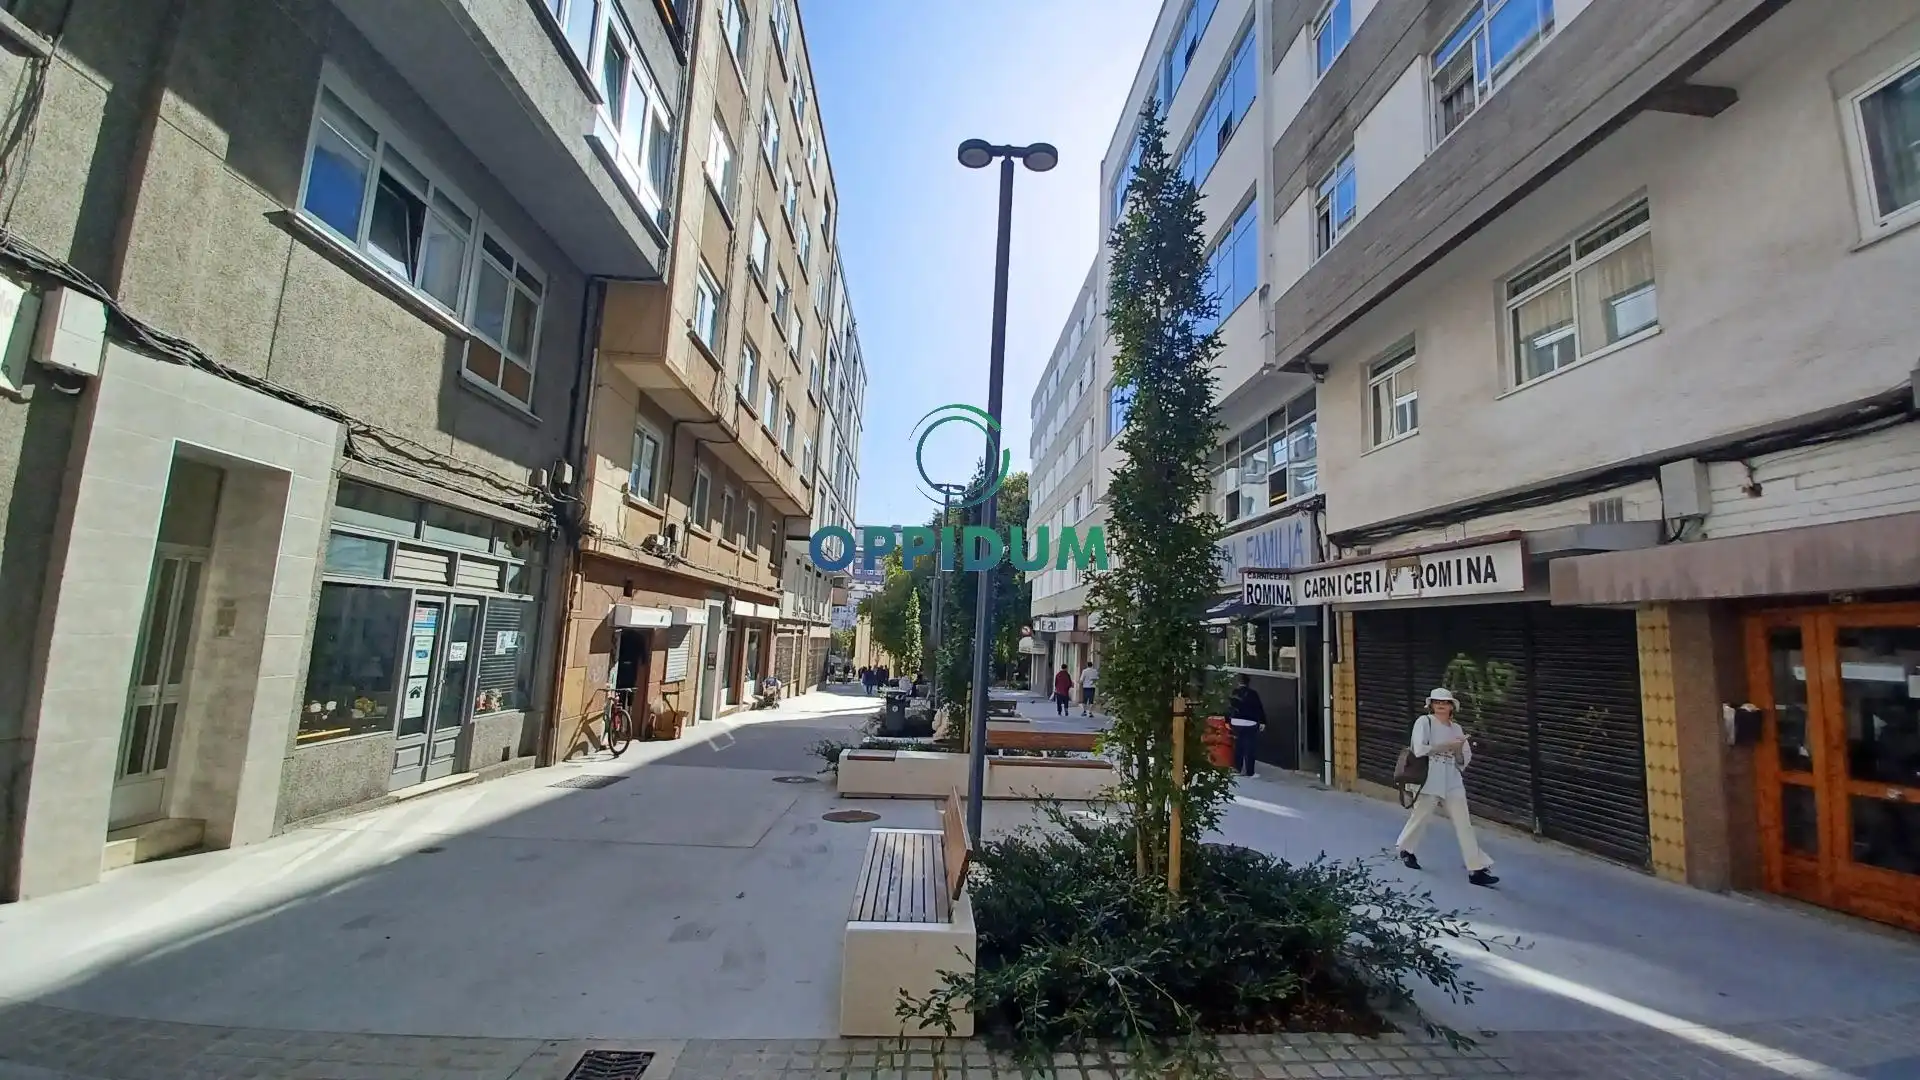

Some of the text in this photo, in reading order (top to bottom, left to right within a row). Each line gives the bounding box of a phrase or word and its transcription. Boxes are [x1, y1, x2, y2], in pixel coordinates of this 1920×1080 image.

[1245, 520, 1304, 569] FAMILIA
[1247, 572, 1290, 581] CARNICERIA
[1304, 554, 1498, 598] CARNICERIA ROMINA
[1245, 583, 1293, 606] ROMINA
